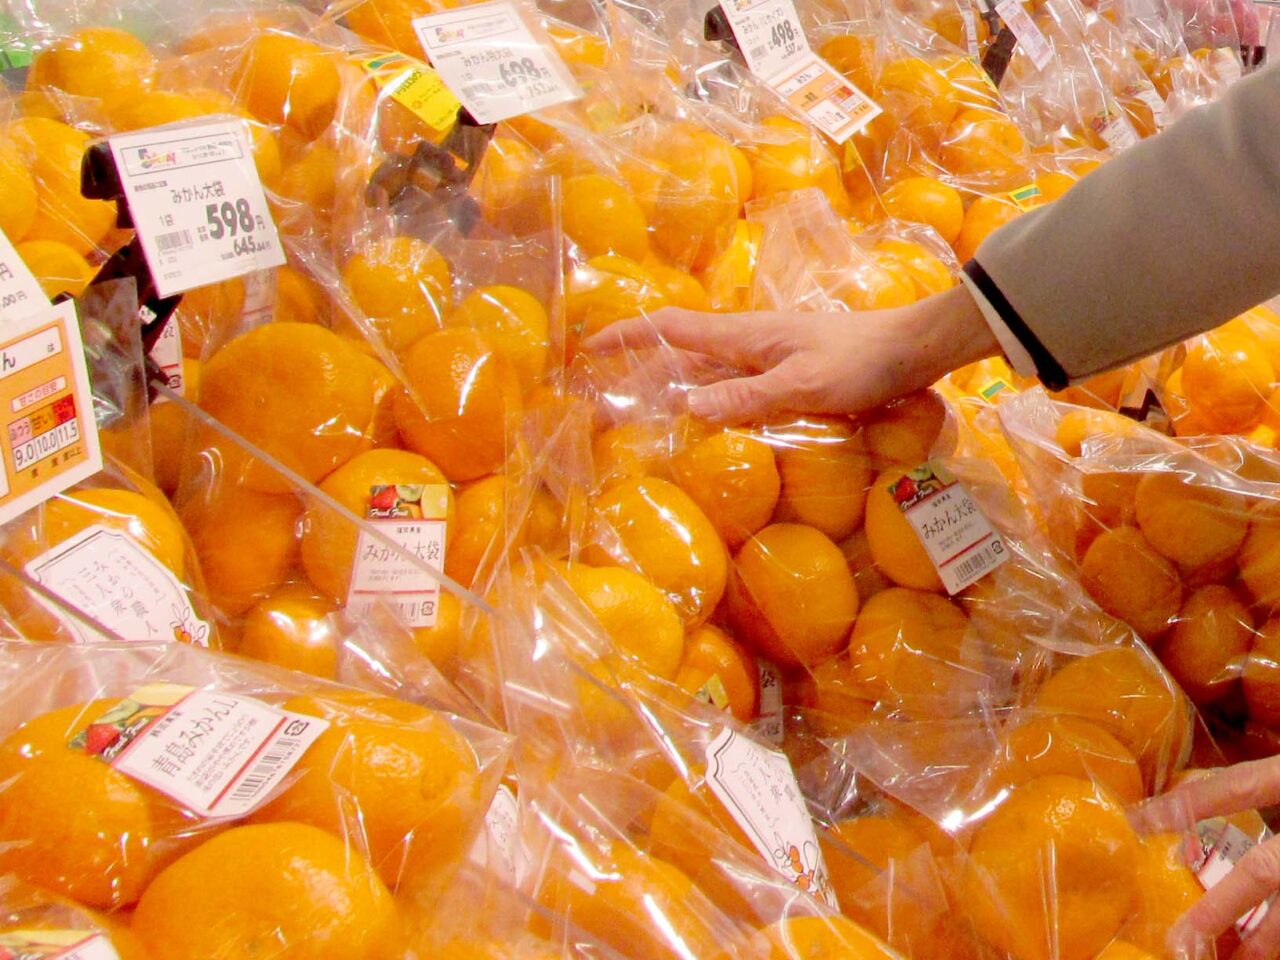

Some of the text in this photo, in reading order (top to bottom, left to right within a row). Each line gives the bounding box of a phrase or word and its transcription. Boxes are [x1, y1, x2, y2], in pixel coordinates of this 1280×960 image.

[170, 181, 226, 204] みかん大袋
[160, 214, 176, 228] 1袋
[9, 412, 52, 440] ふつう 甘い
[15, 421, 78, 466] 9.0 10.0 11.5
[922, 498, 977, 539] みかん大袋
[152, 700, 239, 778] 青島みかんL
